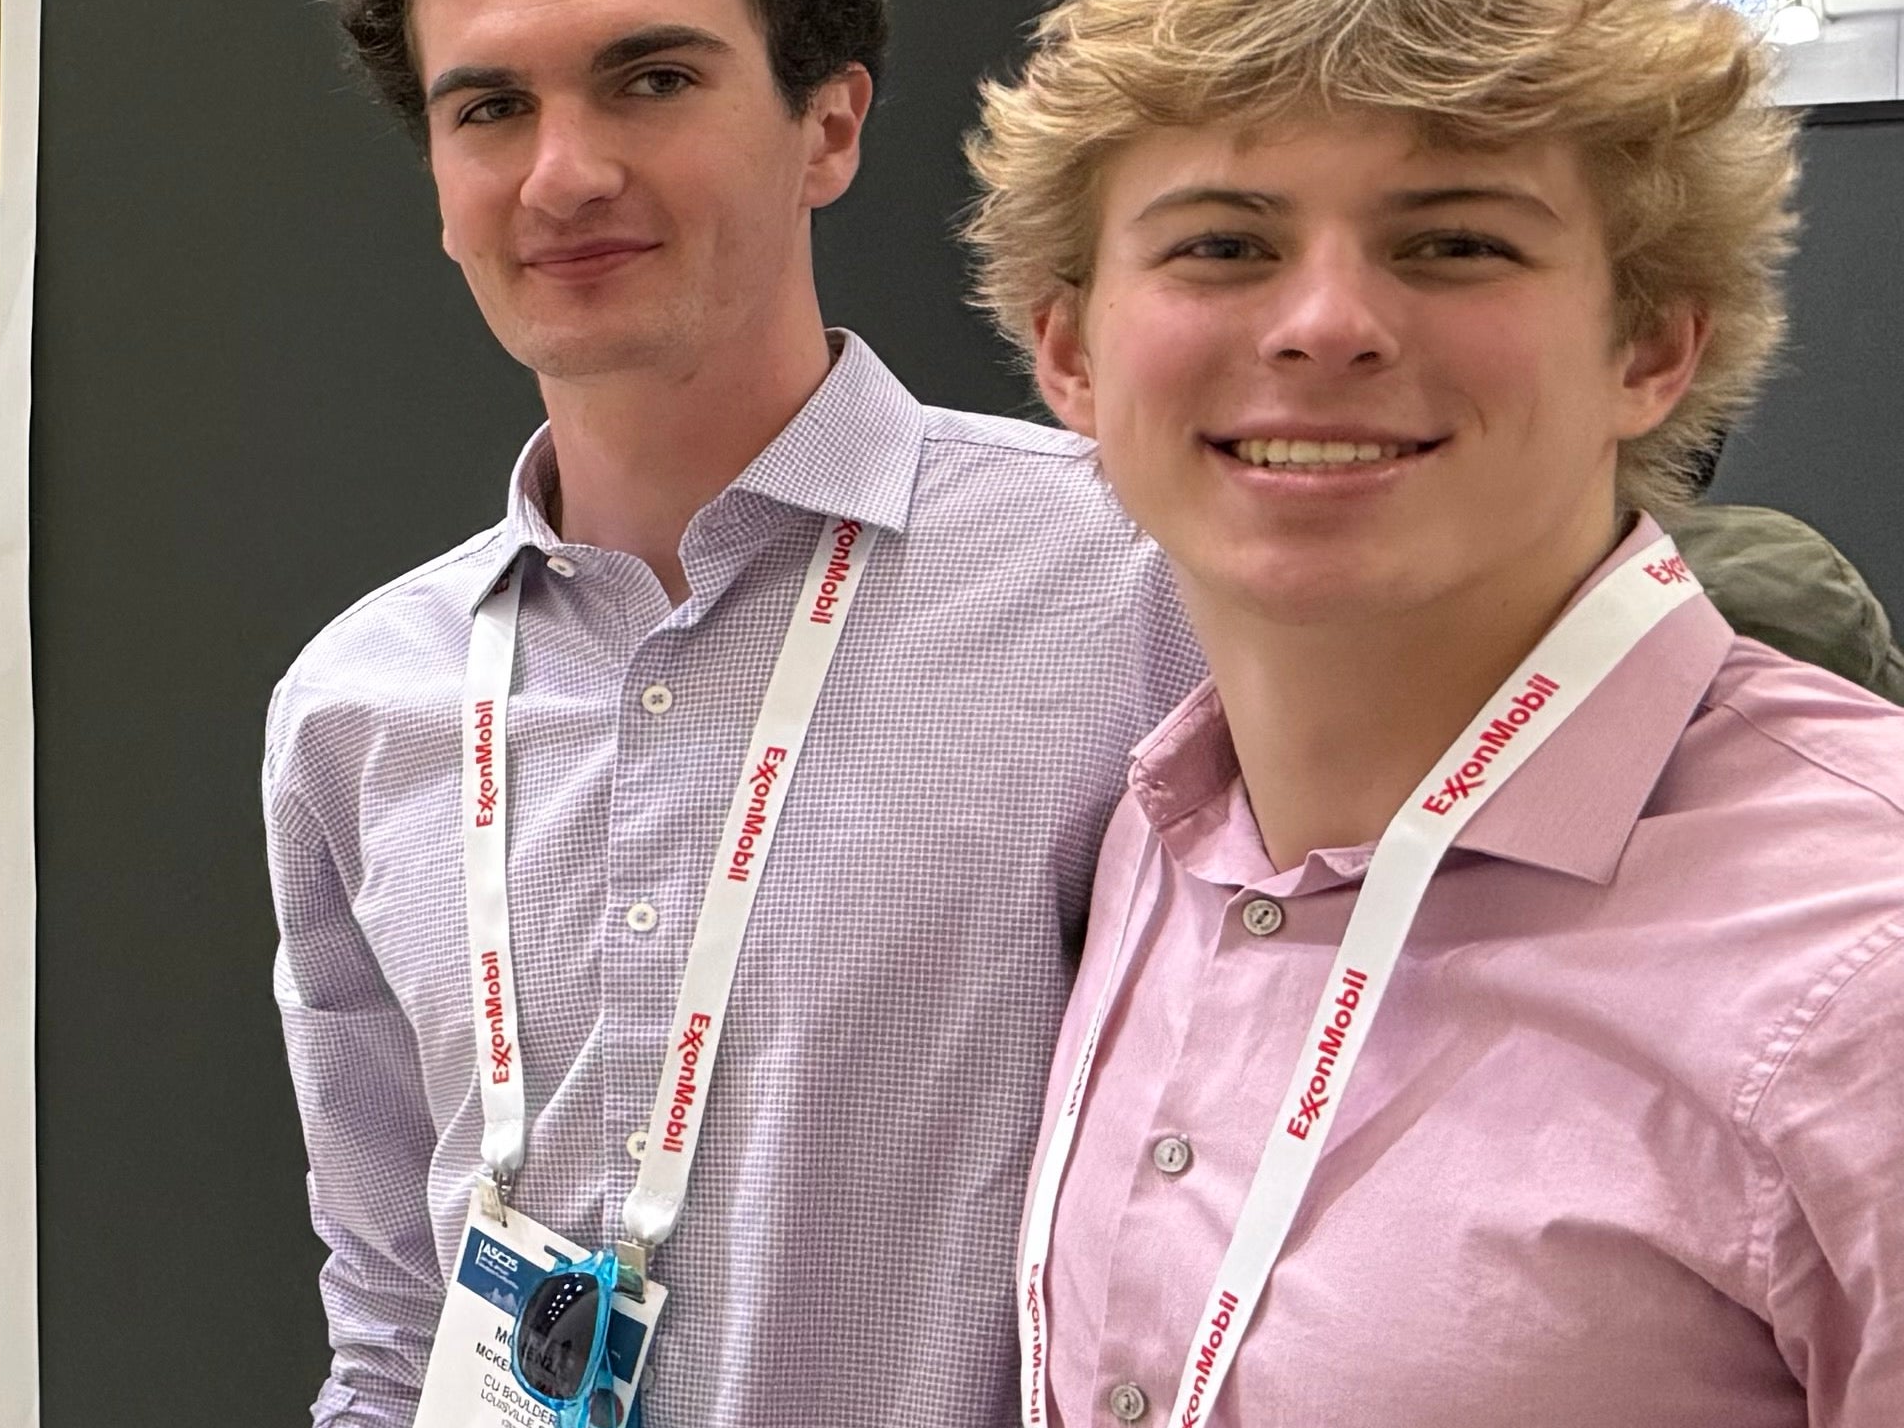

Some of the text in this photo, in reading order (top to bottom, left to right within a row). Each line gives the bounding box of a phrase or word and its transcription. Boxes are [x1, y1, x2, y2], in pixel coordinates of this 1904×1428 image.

[474, 699, 497, 828] ExxonMobil
[730, 745, 788, 883] ExxonMobil
[1422, 671, 1559, 820] ExxonMobil
[486, 950, 512, 1084] ExxonMobil
[660, 1011, 712, 1153] ExxonMobil
[1286, 967, 1370, 1144] ExxonMobil
